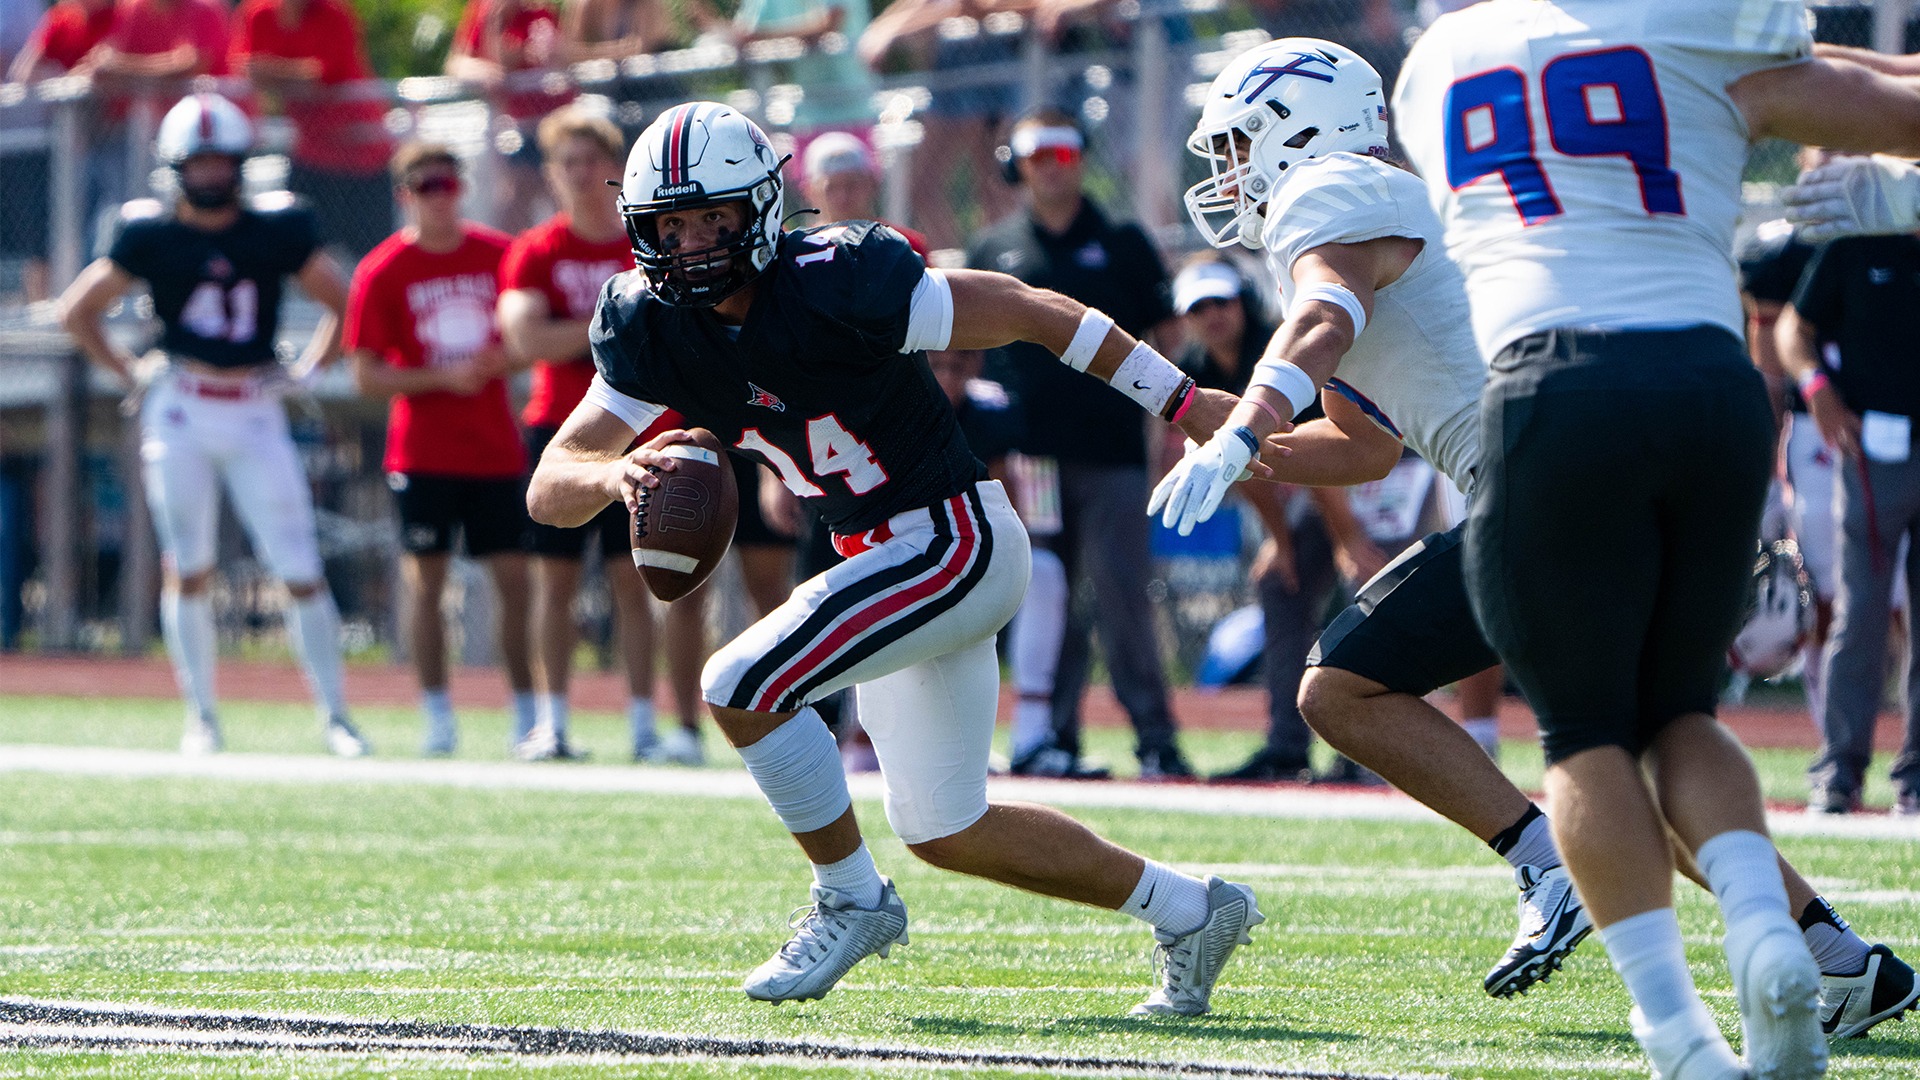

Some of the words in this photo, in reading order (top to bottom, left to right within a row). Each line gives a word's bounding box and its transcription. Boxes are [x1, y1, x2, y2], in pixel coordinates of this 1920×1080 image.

[1443, 45, 1687, 227] 99
[657, 183, 697, 197] Riddell
[795, 225, 849, 268] 14
[180, 280, 259, 342] 41
[733, 412, 889, 497] 14
